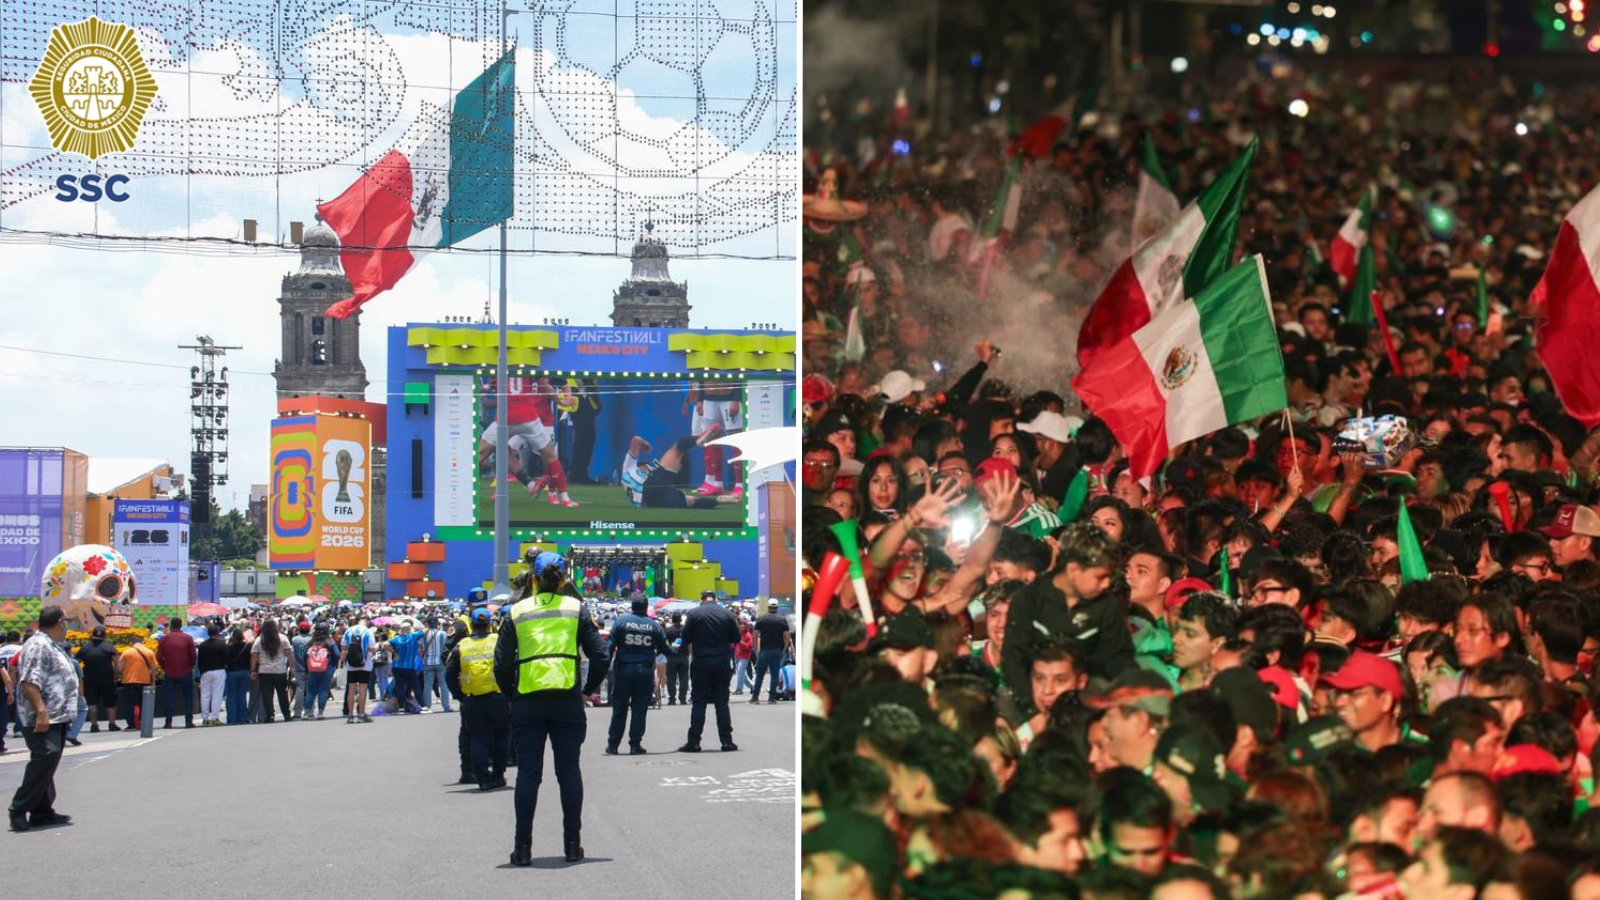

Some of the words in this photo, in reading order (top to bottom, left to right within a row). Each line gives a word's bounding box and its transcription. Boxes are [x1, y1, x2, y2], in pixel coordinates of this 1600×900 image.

[334, 506, 353, 515] FIFA
[590, 520, 635, 529] Hisense
[26, 528, 40, 536] DE
[321, 525, 349, 534] WORLD
[350, 526, 364, 534] CUP
[321, 535, 364, 548] 2026
[625, 633, 652, 647] SSC
